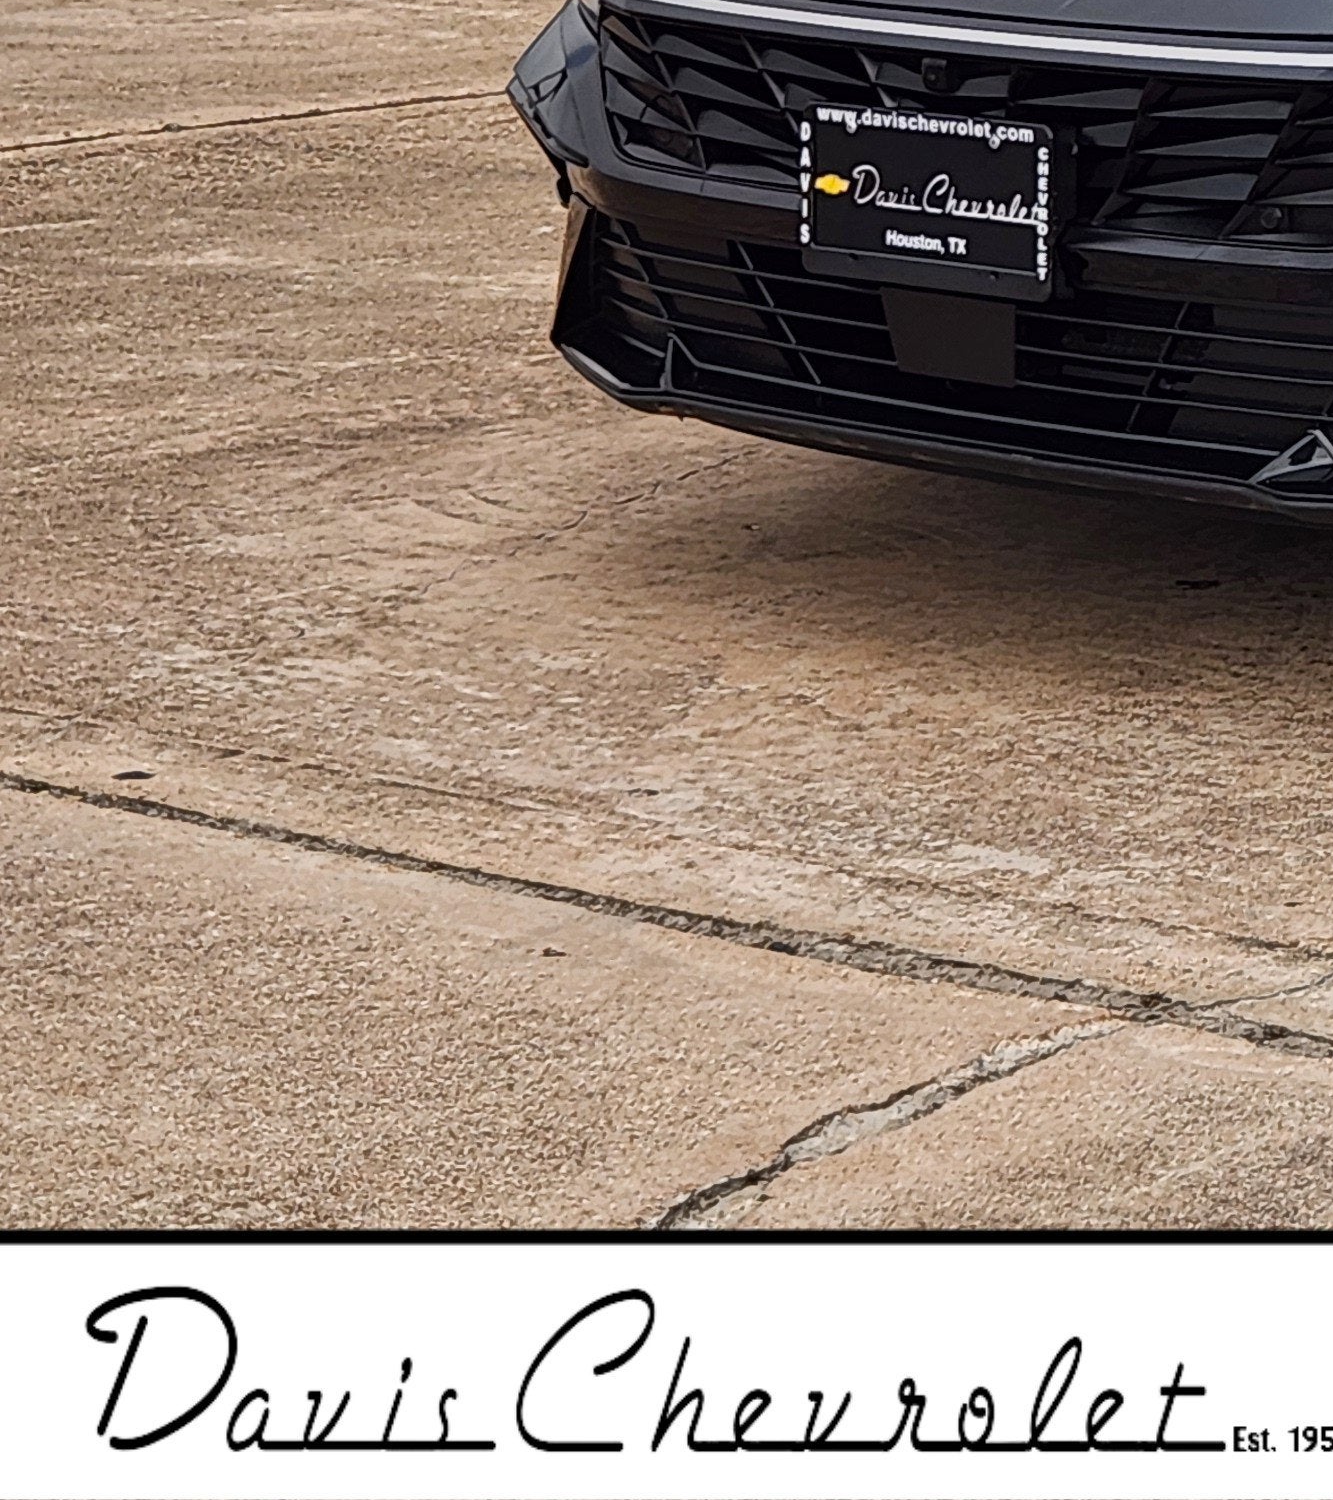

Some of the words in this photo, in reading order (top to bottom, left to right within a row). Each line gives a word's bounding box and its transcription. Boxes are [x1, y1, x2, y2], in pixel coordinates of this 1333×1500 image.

[816, 106, 1035, 145] www.davischevrolet.com
[799, 121, 811, 245] DAVIS
[852, 164, 921, 211] Davis
[922, 173, 1046, 226] Chevrolet
[1037, 146, 1050, 282] CHEVROLET
[885, 229, 944, 255] Houston,
[948, 237, 967, 255] TX
